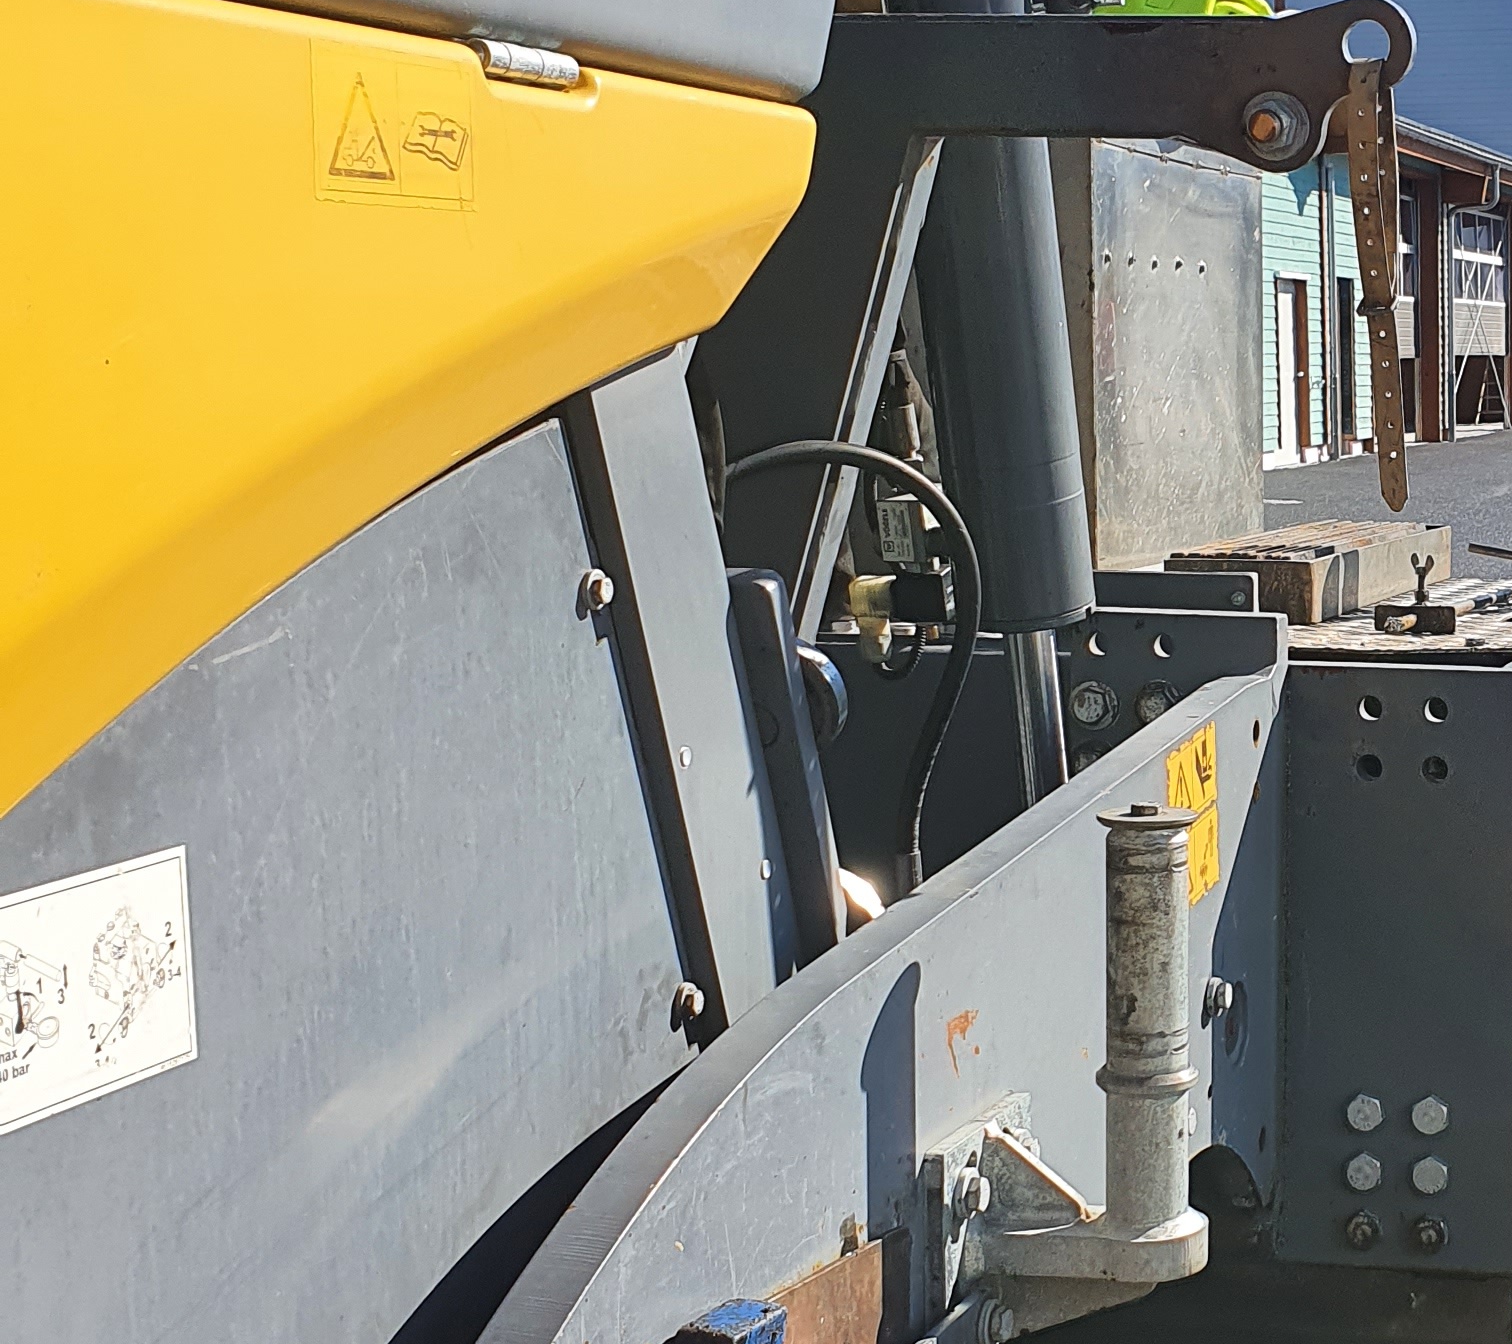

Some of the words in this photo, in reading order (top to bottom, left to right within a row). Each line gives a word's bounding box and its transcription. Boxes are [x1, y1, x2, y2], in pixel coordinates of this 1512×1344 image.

[165, 921, 173, 937] 2
[36, 976, 43, 994] 1
[57, 988, 65, 1005] 3
[88, 1023, 96, 1039] 2
[12, 1063, 31, 1079] bar
